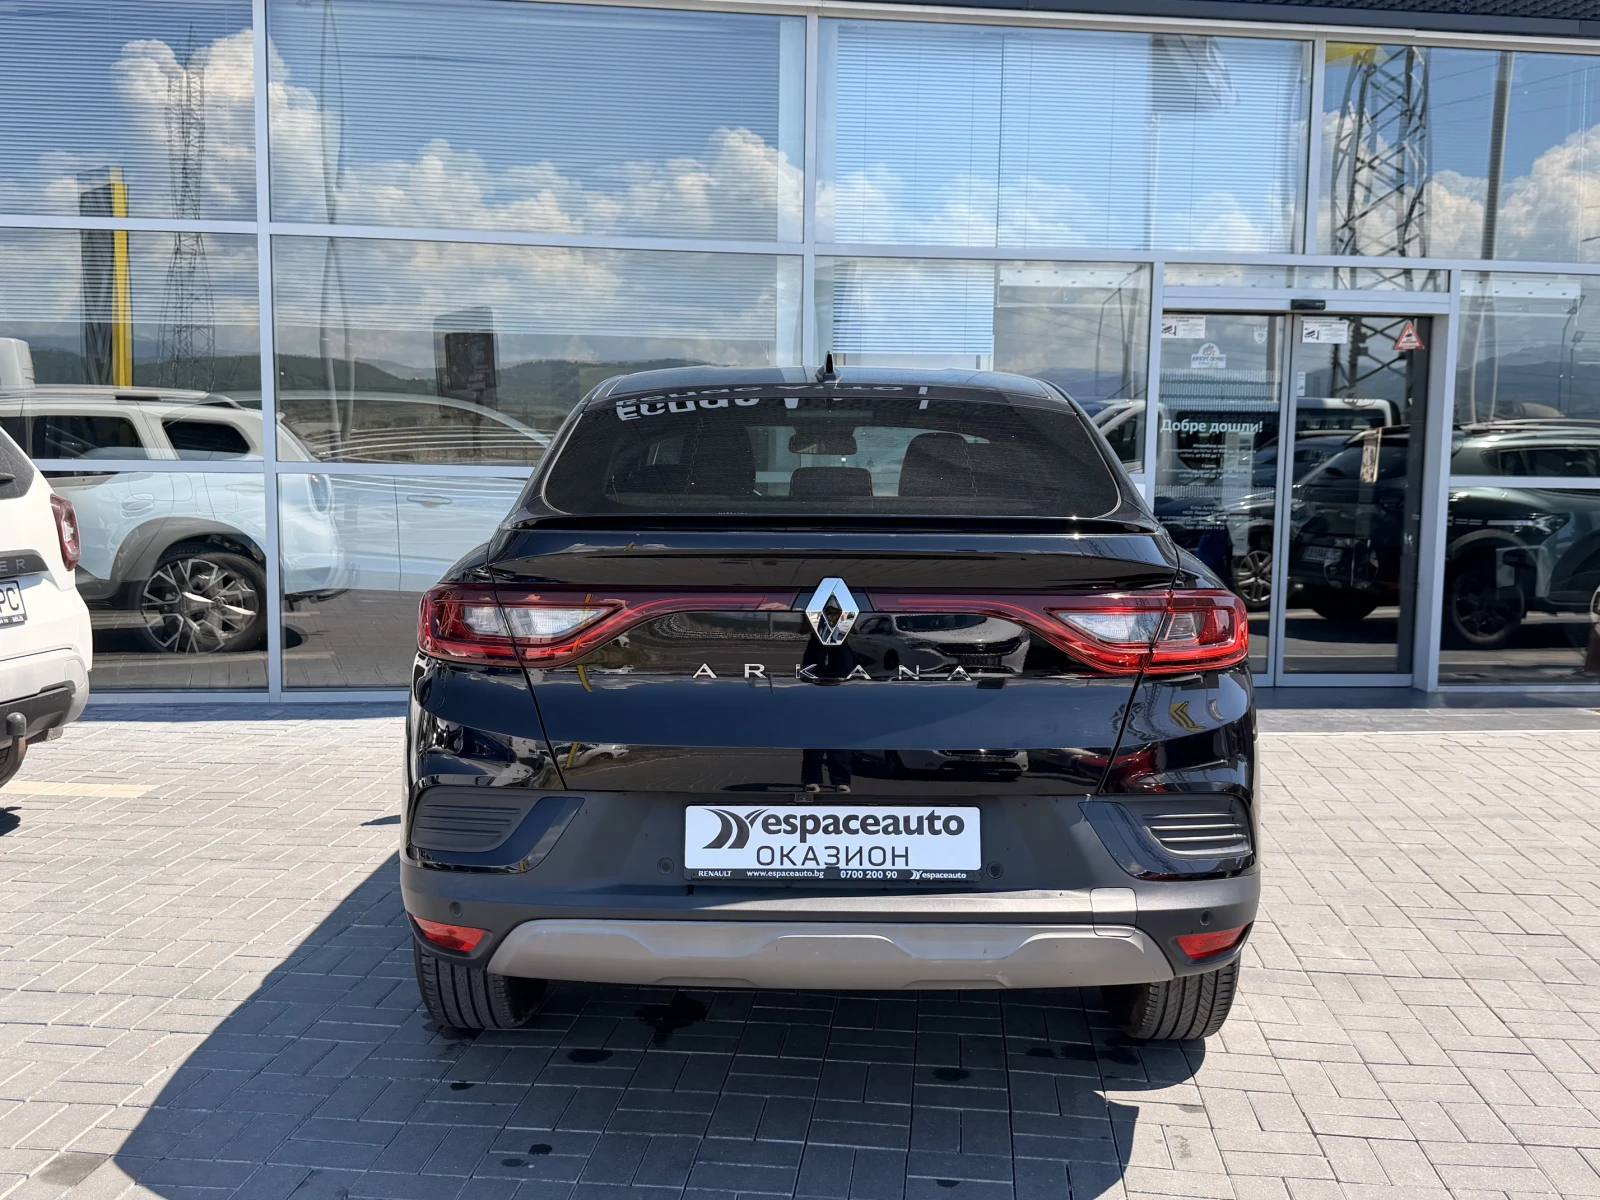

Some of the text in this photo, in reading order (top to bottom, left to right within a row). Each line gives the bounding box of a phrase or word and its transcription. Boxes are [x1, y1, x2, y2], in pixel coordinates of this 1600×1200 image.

[1160, 419, 1264, 435] Добре дошли!
[692, 663, 973, 681] ARKANA
[761, 809, 965, 844] espaceauto
[756, 845, 909, 867] ОКАЗИОН
[746, 869, 825, 880] www.espaceauto.bg
[840, 870, 898, 879] 0700 200 90
[922, 871, 967, 880] espaceauto
